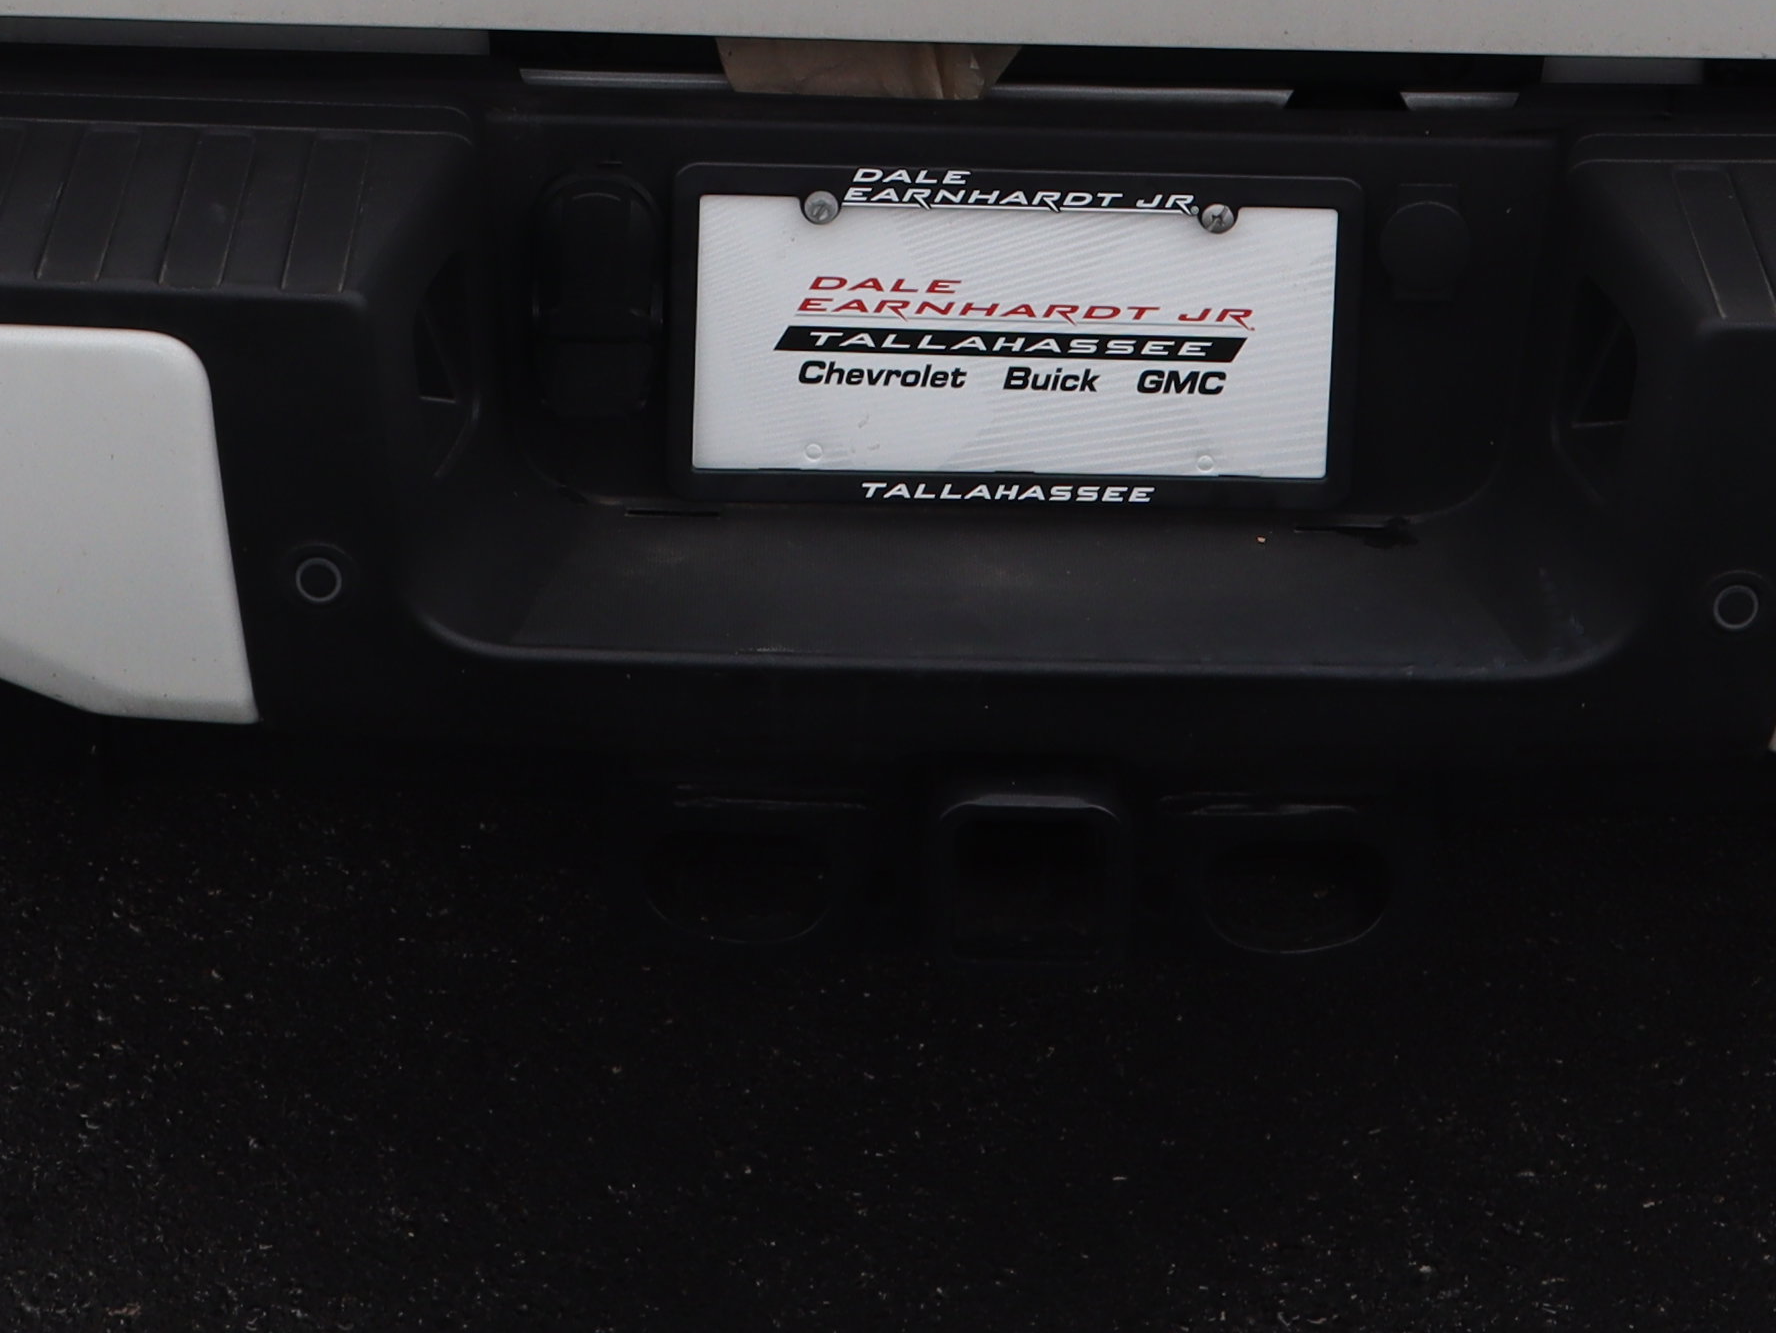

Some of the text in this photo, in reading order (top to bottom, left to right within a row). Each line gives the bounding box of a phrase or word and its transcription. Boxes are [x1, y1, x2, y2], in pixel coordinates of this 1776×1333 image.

[852, 169, 970, 185] DALE
[842, 187, 1123, 212] EARNHARDT
[808, 276, 962, 295] DALE
[797, 298, 1162, 325] EARNHARDT
[809, 331, 1213, 357] TALLAHASSEE
[798, 360, 1227, 396] Chevrolet Buick GMC
[861, 482, 1155, 503] TALLAHASSEE
